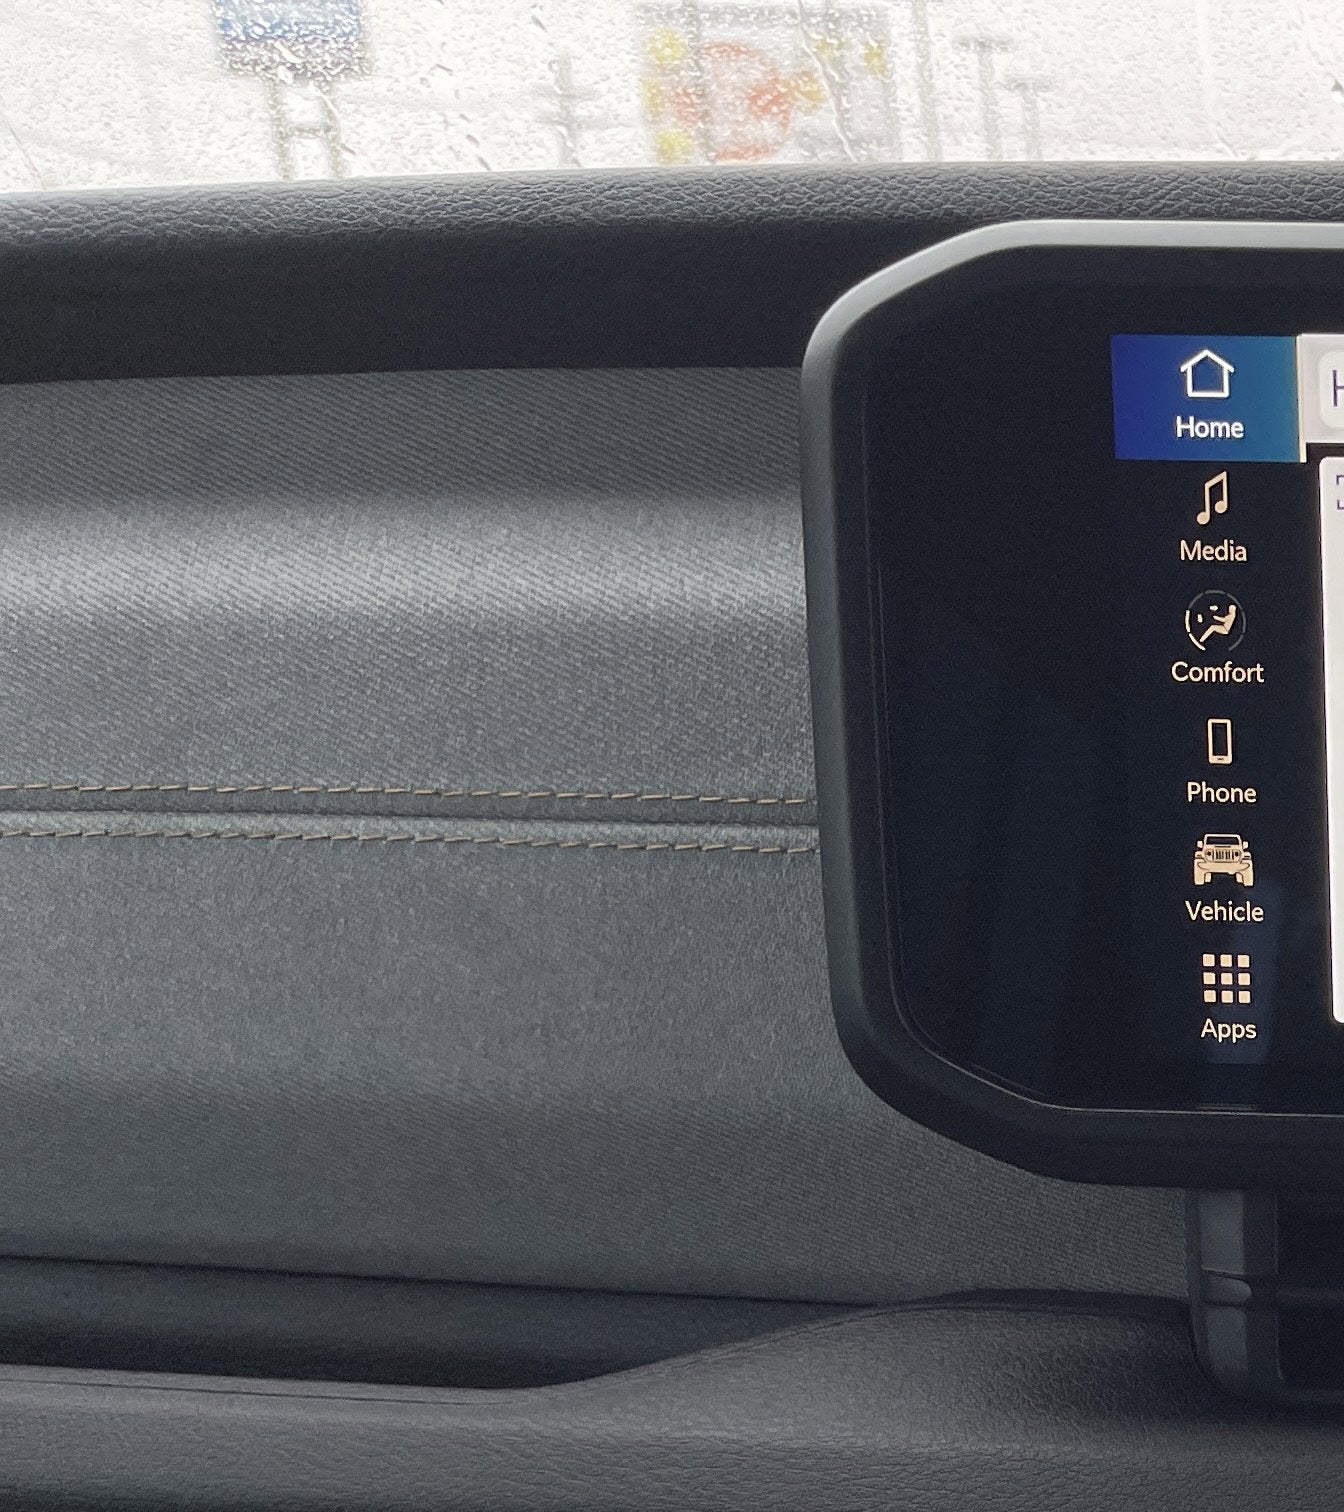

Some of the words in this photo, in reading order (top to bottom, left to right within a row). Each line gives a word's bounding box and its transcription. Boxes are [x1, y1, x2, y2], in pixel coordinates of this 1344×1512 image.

[1176, 417, 1244, 438] Home
[1180, 541, 1247, 562] Media
[1171, 662, 1264, 683] Comfort
[1187, 782, 1257, 804] Phone
[1185, 901, 1264, 922] Vehicle
[1201, 1019, 1257, 1043] Apps
